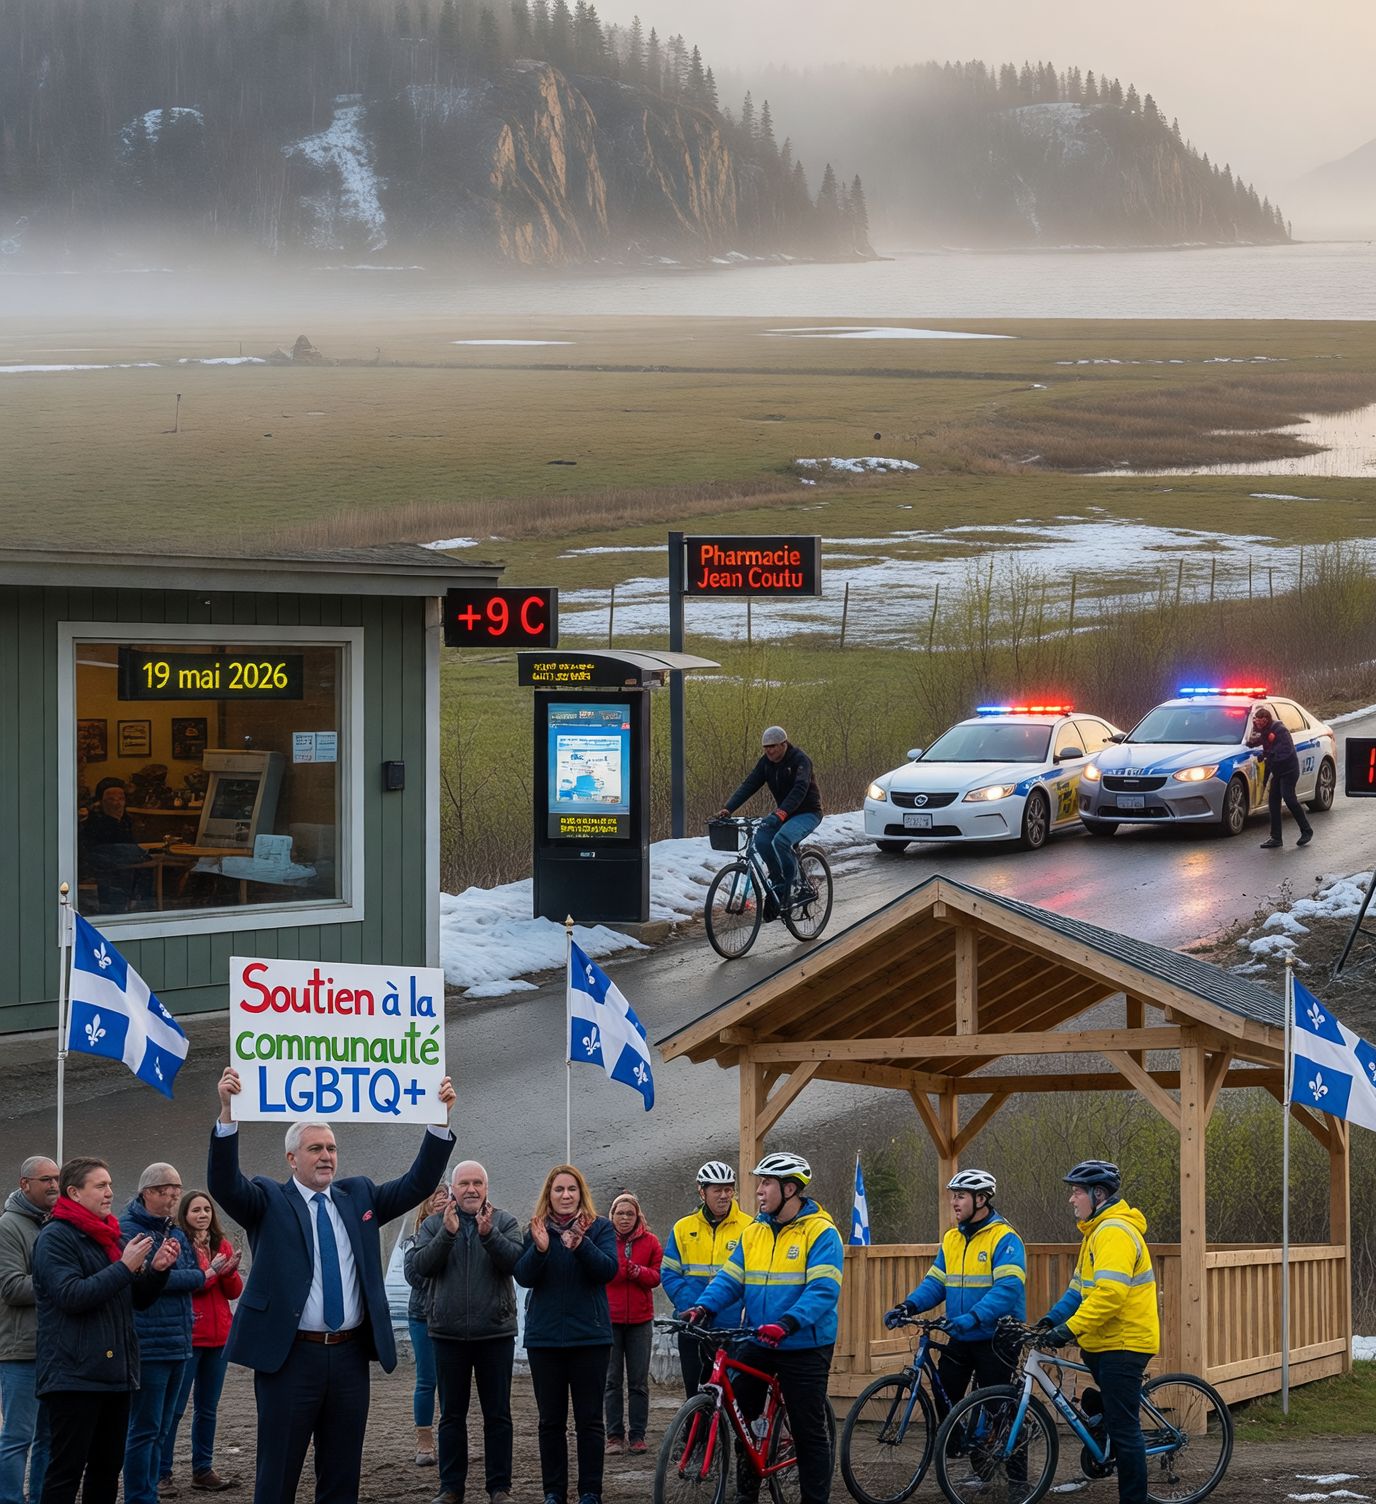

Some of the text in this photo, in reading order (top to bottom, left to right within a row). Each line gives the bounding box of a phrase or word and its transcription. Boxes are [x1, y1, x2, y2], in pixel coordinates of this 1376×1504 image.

[700, 544, 801, 566] Pharmacie
[697, 567, 803, 588] Jean Coutu
[457, 596, 546, 636] +9 C
[142, 661, 289, 690] 19 mai 2026
[239, 962, 437, 1018] Soutien à la
[235, 1021, 441, 1066] communauté
[258, 1065, 426, 1116] LGBTQ+
